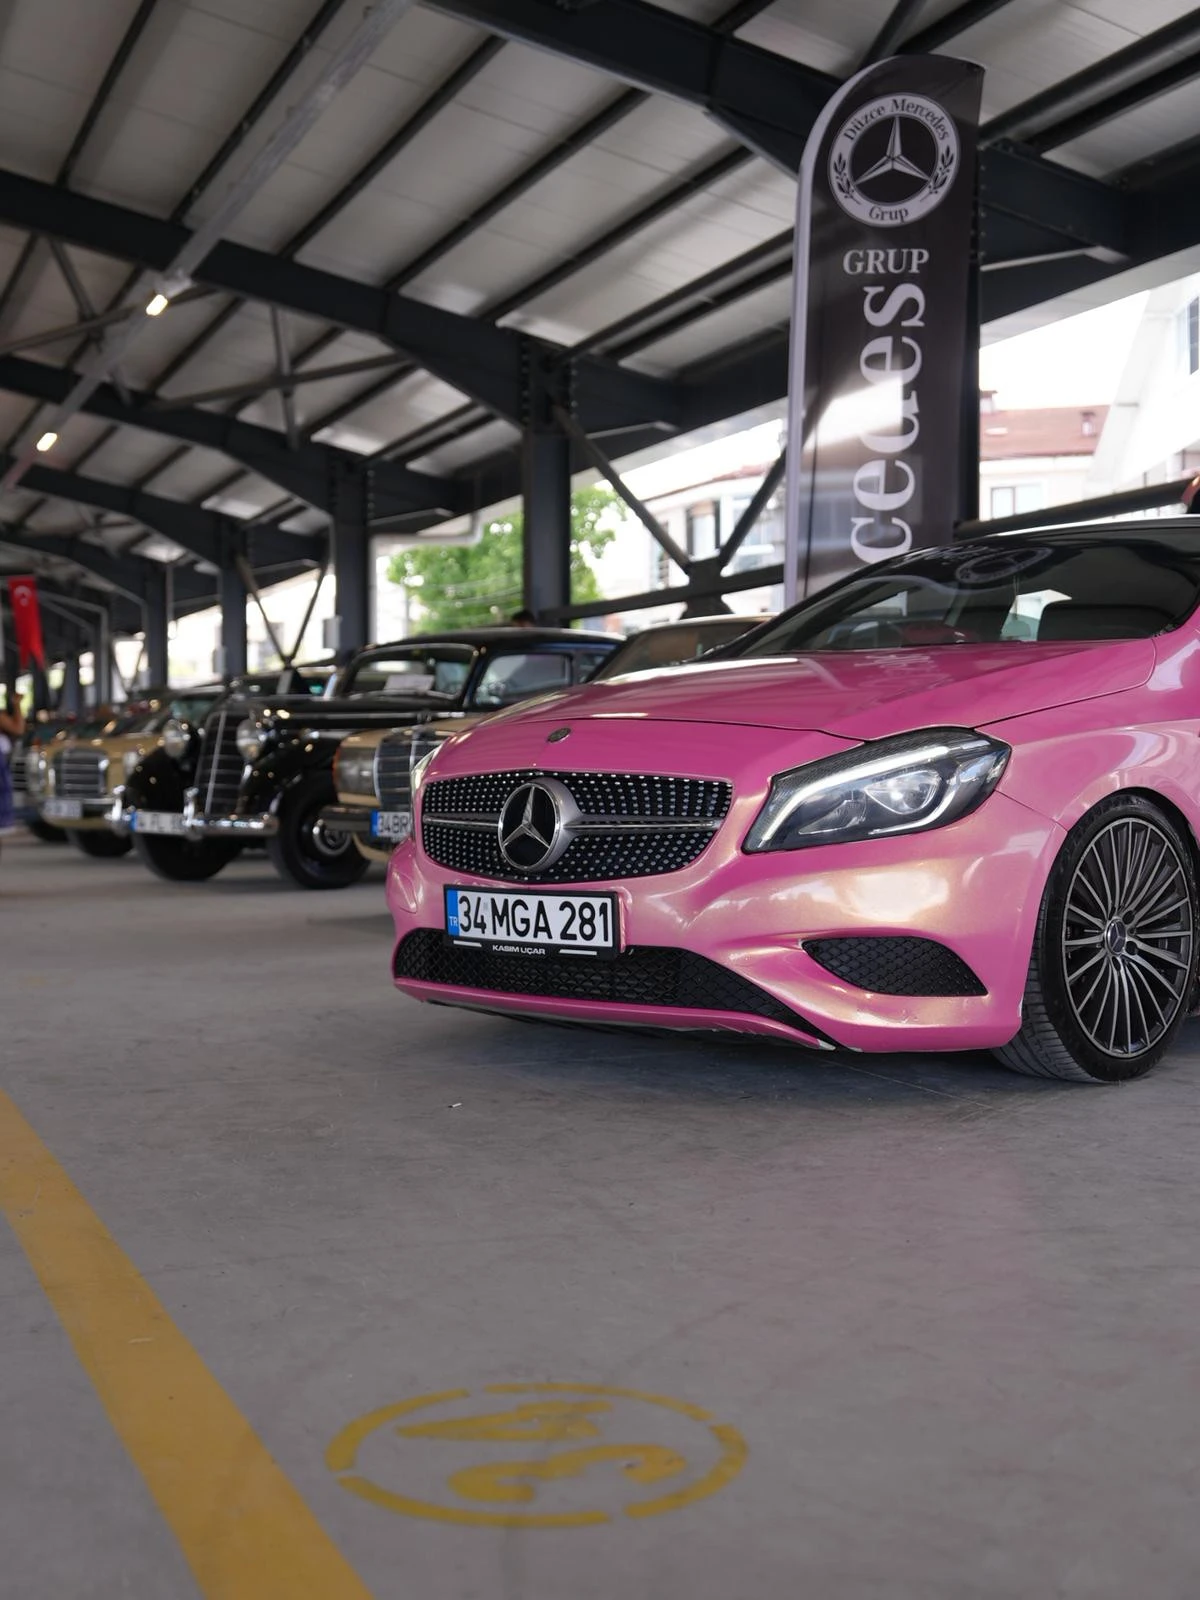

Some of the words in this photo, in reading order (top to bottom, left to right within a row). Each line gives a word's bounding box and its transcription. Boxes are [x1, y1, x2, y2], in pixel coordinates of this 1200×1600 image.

[843, 104, 886, 141] Düzce
[890, 98, 950, 141] Mercedes
[868, 205, 909, 223] Grup
[842, 248, 930, 275] GRUP
[559, 901, 609, 942] 281
[492, 944, 520, 953] KASIM
